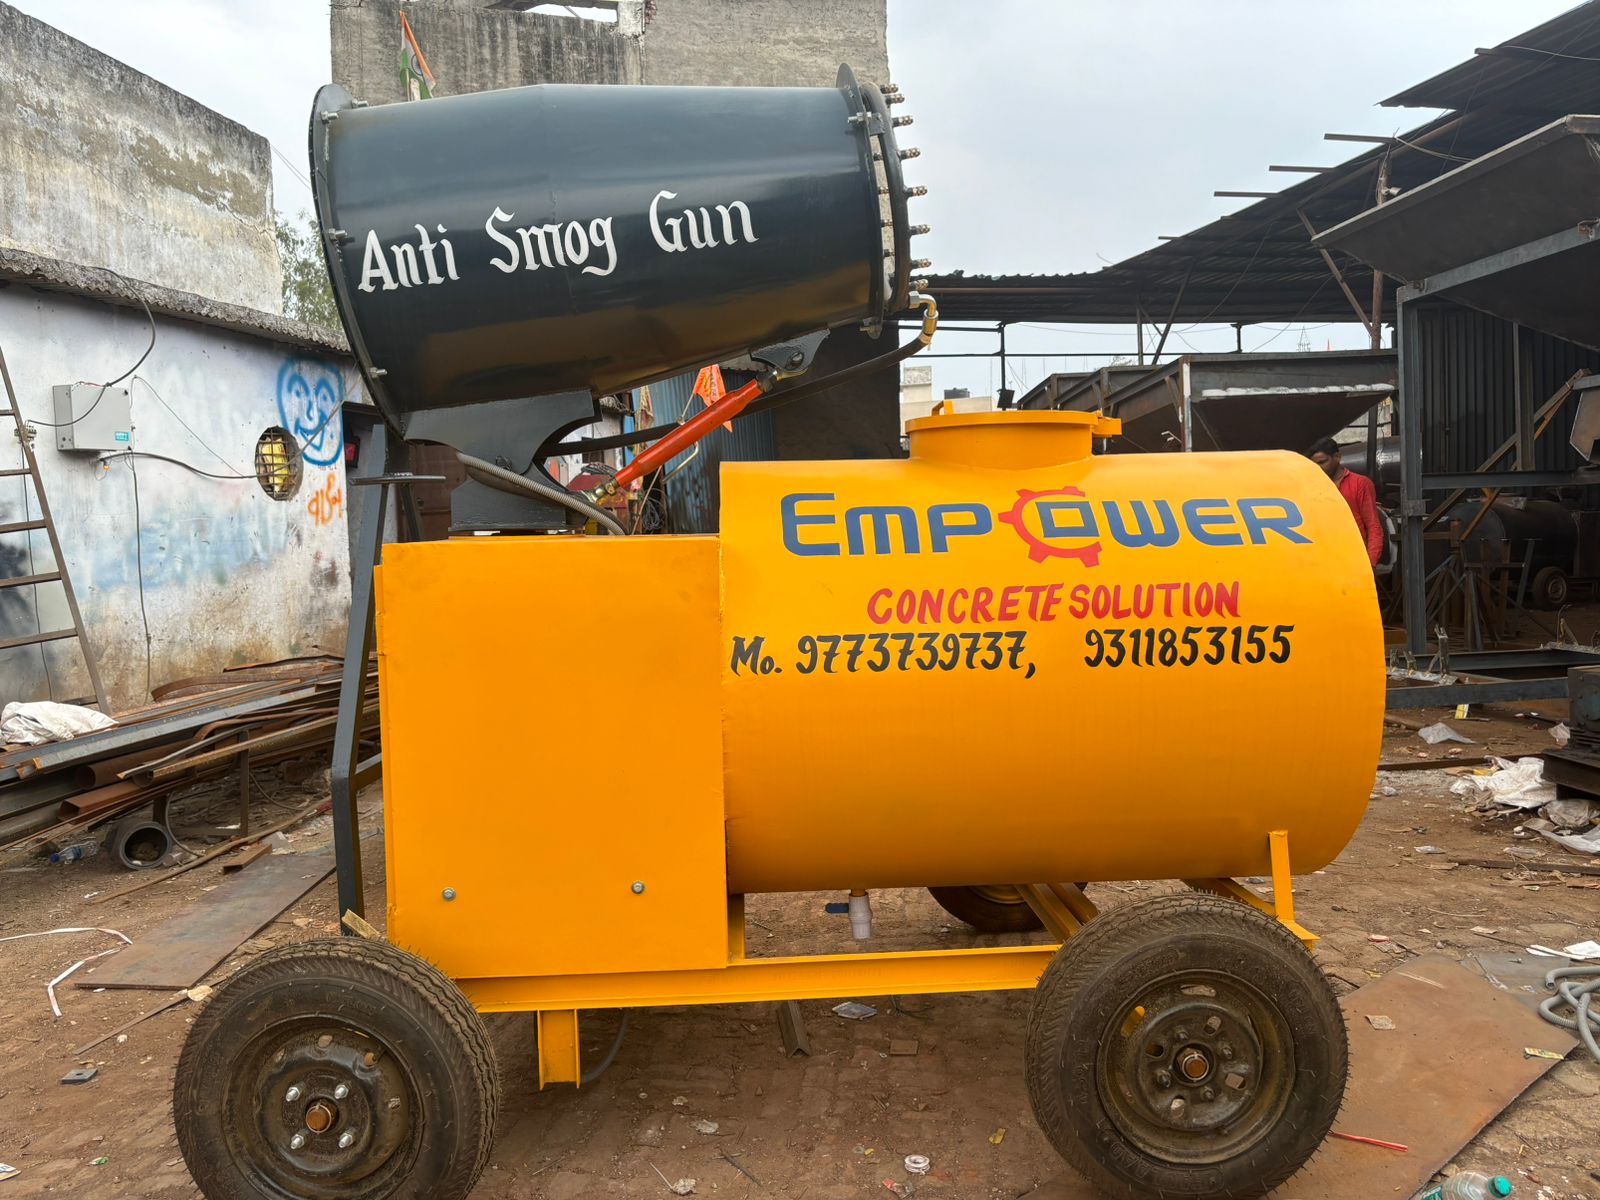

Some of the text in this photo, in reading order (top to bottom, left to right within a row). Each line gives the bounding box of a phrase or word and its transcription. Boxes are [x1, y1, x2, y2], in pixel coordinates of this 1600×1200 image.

[357, 189, 760, 294] Anti Smog Gun
[866, 580, 1241, 625] CONCRETE SOLUTION
[730, 624, 1296, 680] Mo. 9773739737, 9311853155
